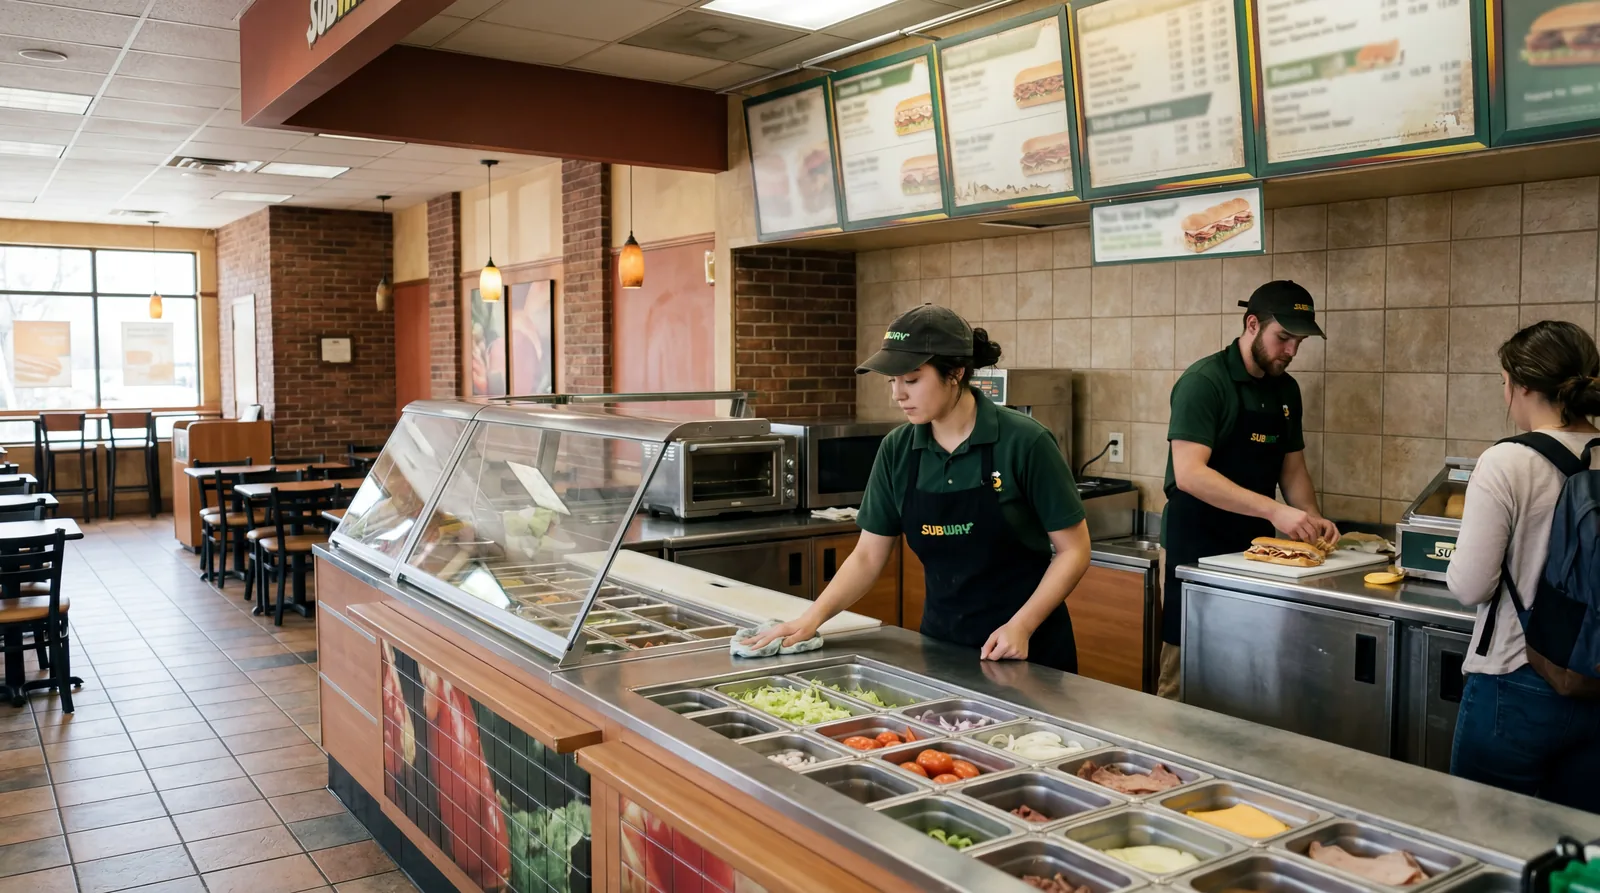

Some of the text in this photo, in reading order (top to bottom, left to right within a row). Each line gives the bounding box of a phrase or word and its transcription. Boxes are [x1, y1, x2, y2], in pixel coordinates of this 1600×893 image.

[306, 0, 358, 50] SUB
[884, 331, 910, 341] WAY
[1250, 432, 1279, 443] SUB
[921, 522, 974, 536] SUBWAY
[1435, 547, 1452, 559] SU
